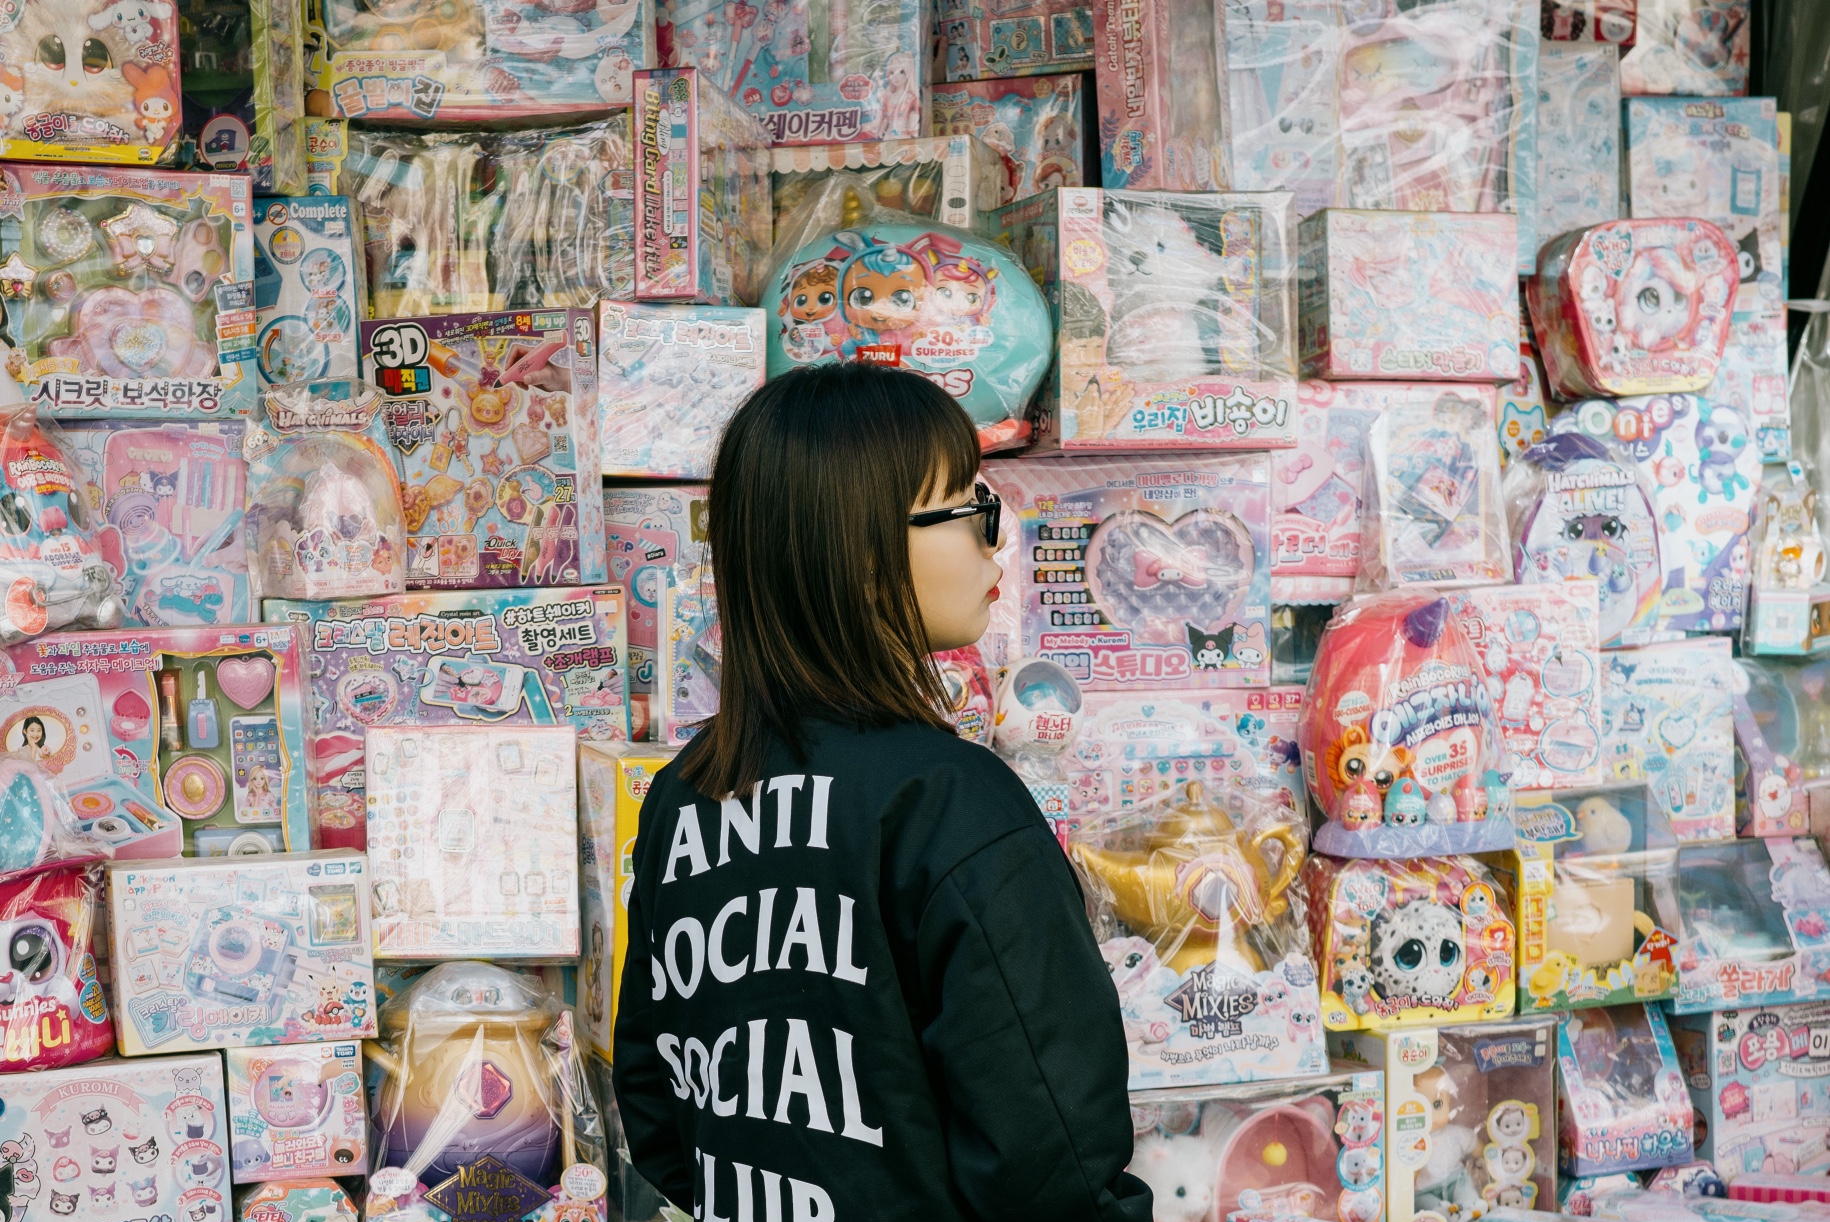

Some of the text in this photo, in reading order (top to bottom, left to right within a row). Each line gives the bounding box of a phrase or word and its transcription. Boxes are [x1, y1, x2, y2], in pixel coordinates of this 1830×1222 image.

[345, 58, 385, 71] 종알종알
[308, 136, 338, 154] 콩순이
[214, 161, 238, 170] micro
[32, 171, 50, 185] 식물
[233, 203, 246, 214] 6+
[289, 202, 347, 220] Complete
[372, 324, 428, 367] 3D
[926, 329, 964, 348] 30+
[862, 350, 896, 363] ZURU
[915, 346, 975, 358] SURPRISES
[383, 367, 430, 392] 매직펜
[31, 378, 223, 411] 시크릿 보석화장
[1132, 386, 1290, 436] 우리집 비숑이
[555, 485, 572, 503] 27
[1558, 489, 1626, 514] ALIVE!
[61, 543, 71, 552] 15
[486, 536, 517, 549] Quick
[51, 558, 84, 566] SURPRISES
[501, 549, 521, 559] Dry
[504, 602, 592, 625] #하트쉐이커
[254, 635, 268, 645] 6+
[316, 620, 499, 653] 크리스탈 레진아트
[521, 625, 594, 651] 촬영세트
[1044, 634, 1128, 648] My Melody Kuromi
[36, 639, 151, 657] 꽃과 과일 추출물로 보습에
[30, 663, 56, 675] 도움을
[57, 662, 76, 675] 주는
[77, 659, 112, 673] 저자극
[545, 647, 615, 669] +조개램프
[1092, 651, 1192, 678] 스튜디오
[1036, 714, 1072, 732] 햄스터
[1424, 740, 1467, 765] OVER 35
[1420, 756, 1475, 778] SURPRISES
[1427, 776, 1439, 786] TO
[661, 774, 835, 885] ANTI
[1191, 971, 1240, 995] Magic
[139, 998, 181, 1018] 크리스탈
[151, 1004, 269, 1039] 키링메이커
[1190, 1022, 1216, 1039] 마법
[1160, 1050, 1194, 1065] 마법으로
[1402, 1048, 1428, 1063] 콩순이
[58, 1081, 121, 1099] KUROMI
[656, 1017, 884, 1148] SOCIAL
[1586, 1129, 1690, 1164] 나나핑 하우스
[457, 1164, 517, 1191] Magic
[574, 1166, 594, 1178] 50+
